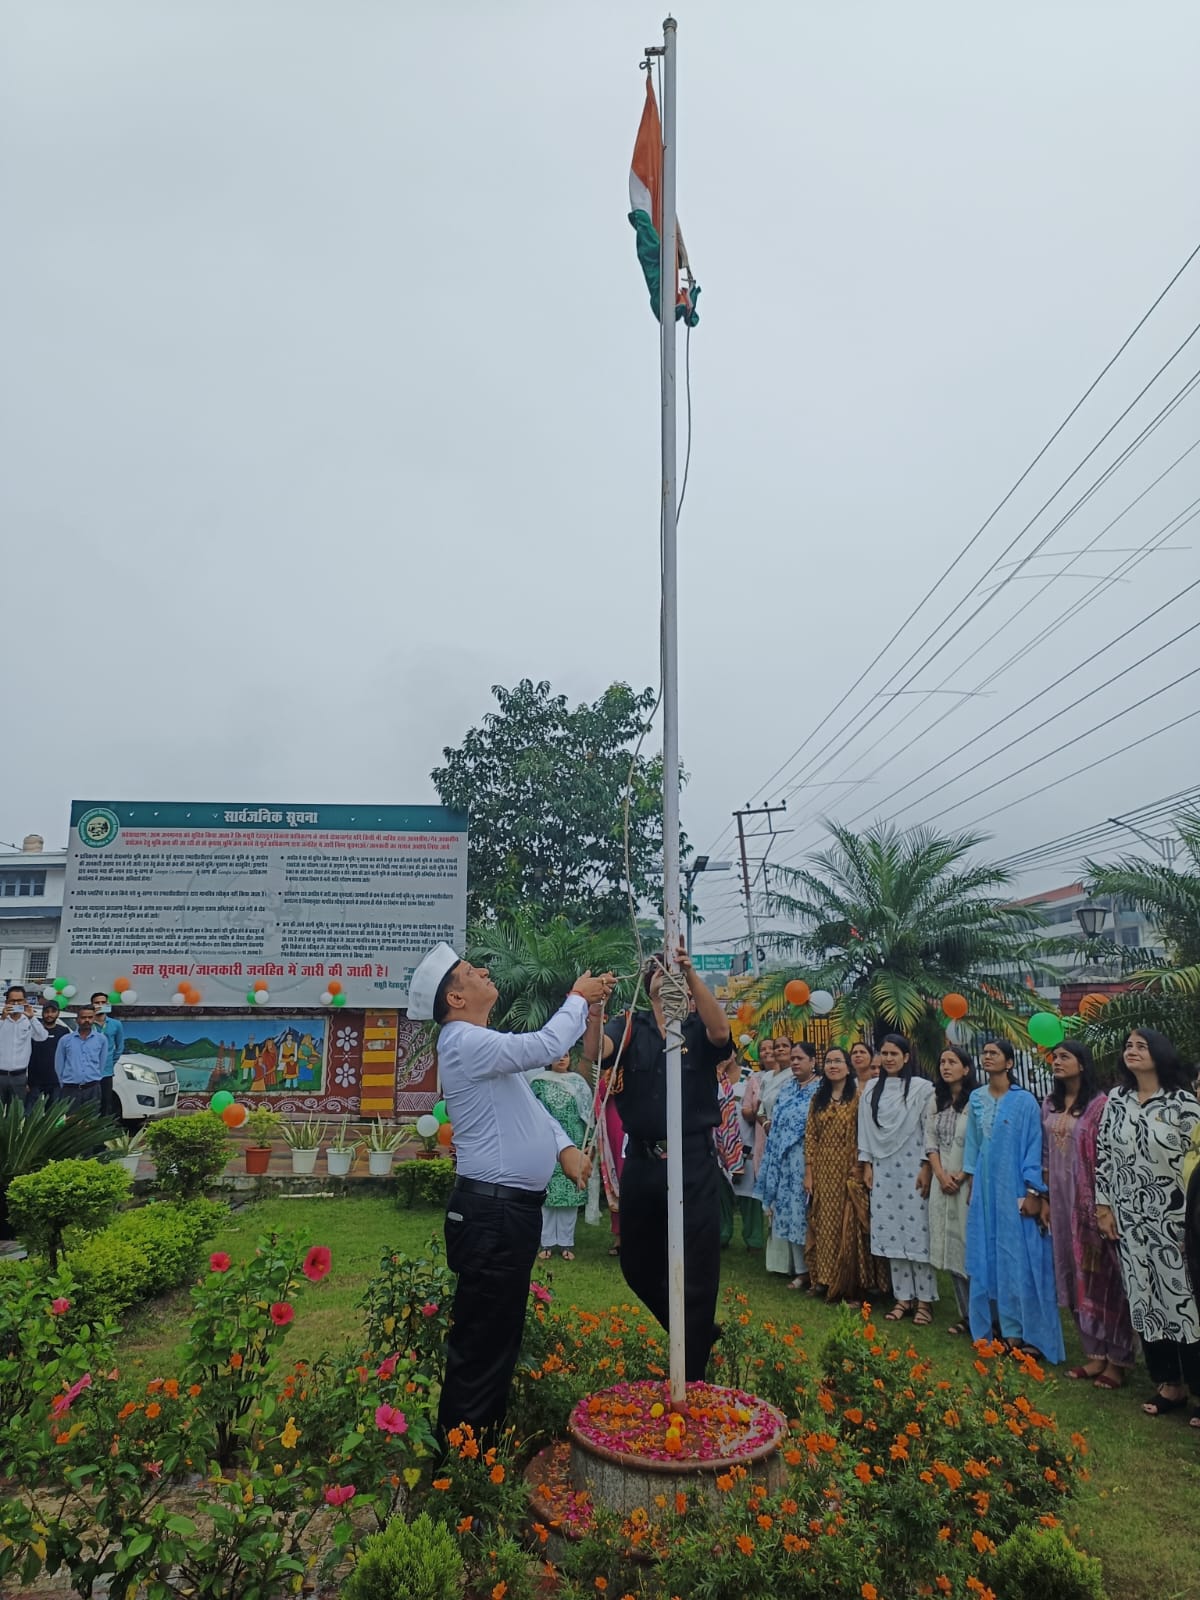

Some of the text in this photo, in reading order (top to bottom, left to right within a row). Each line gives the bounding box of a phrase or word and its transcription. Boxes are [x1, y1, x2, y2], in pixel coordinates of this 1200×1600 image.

[224, 808, 318, 827] सार्वजनिक सूचना
[132, 964, 154, 975] उक्त
[158, 962, 242, 979] सूचना/जानकारी
[246, 962, 284, 976] जनहित
[288, 962, 298, 976] में
[301, 963, 324, 977] जारी
[328, 963, 342, 977] की
[347, 963, 372, 977] जाती
